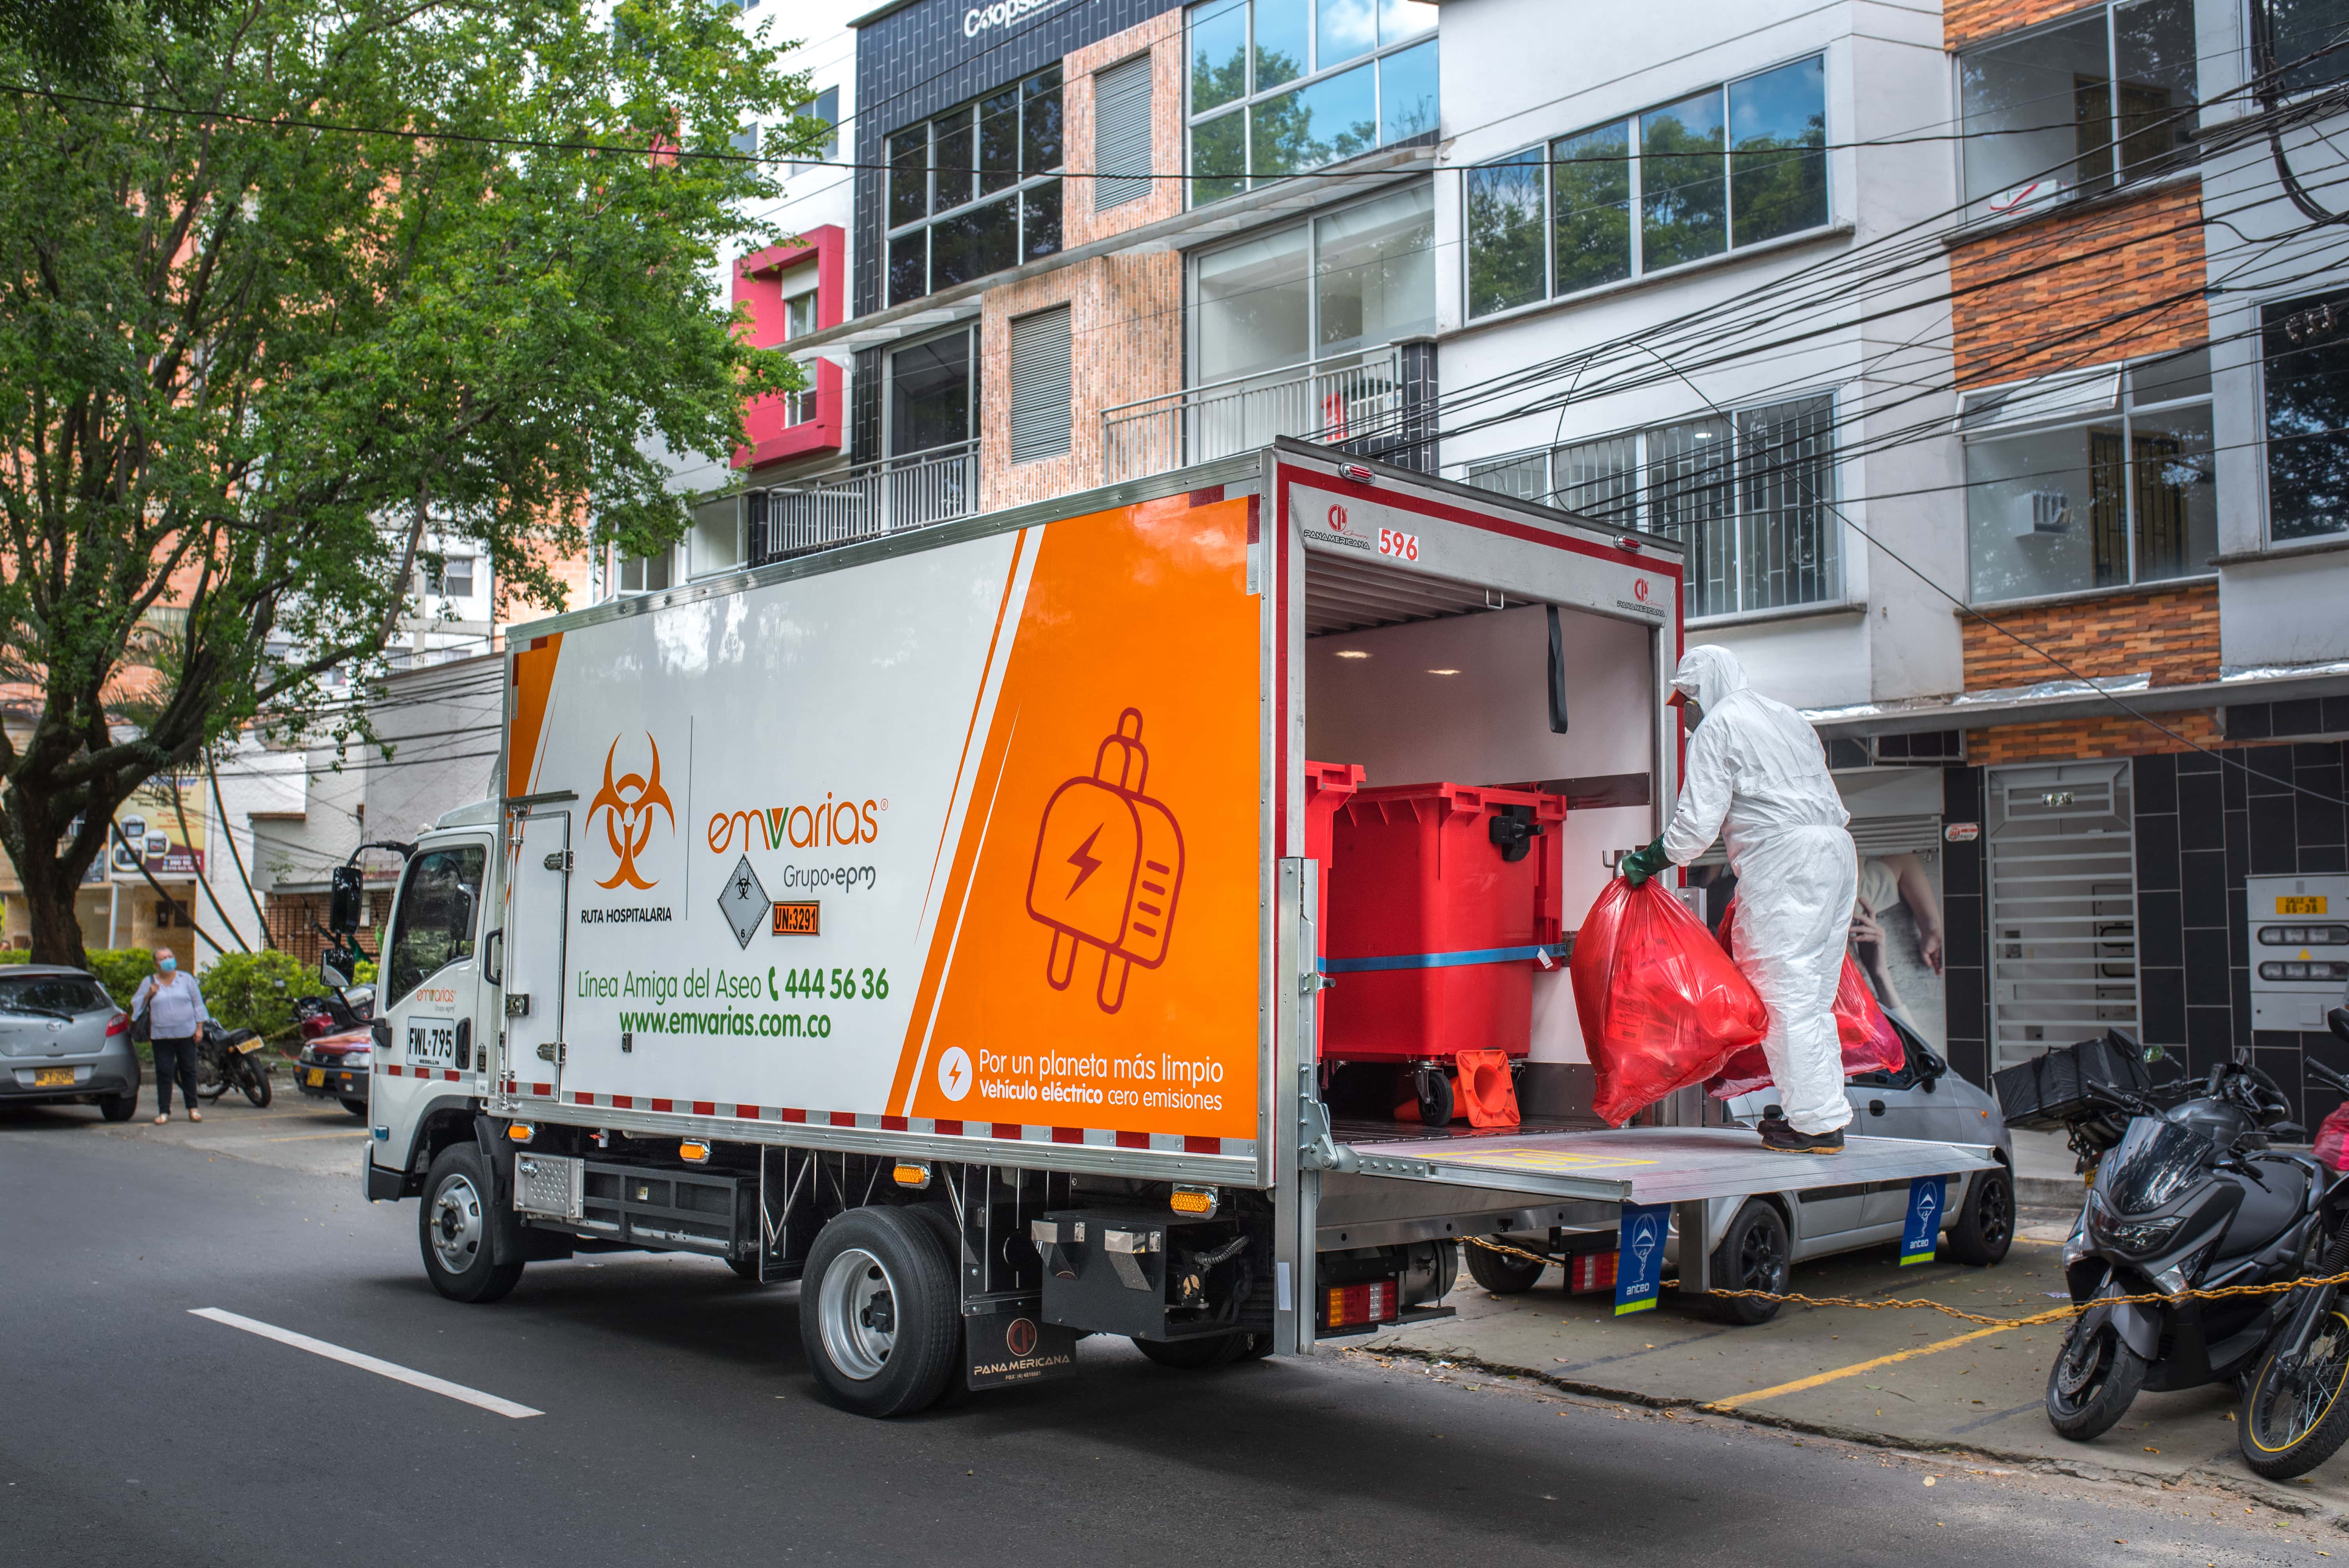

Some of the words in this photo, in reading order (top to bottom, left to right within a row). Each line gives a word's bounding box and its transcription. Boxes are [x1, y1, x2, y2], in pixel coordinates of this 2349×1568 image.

[1304, 529, 1370, 550] PANAMERICANA
[1380, 529, 1417, 561] 596
[1617, 600, 1665, 617] PANAMERICANA
[581, 909, 604, 923] RUTA
[606, 907, 672, 923] HOSPITALARIA
[775, 908, 815, 930] UN:3291
[2286, 904, 2318, 913] 66-38
[741, 929, 745, 938] 6
[578, 971, 618, 998] Línea
[624, 970, 677, 1005] Amiga
[684, 968, 709, 998] del
[715, 969, 761, 998] Aseo
[784, 968, 825, 999] 444
[830, 968, 856, 999] 56
[861, 968, 889, 1000] 36
[620, 1005, 831, 1038] www.emvarias.com.co
[980, 1049, 1007, 1073] Por
[1012, 1055, 1033, 1074] un
[1040, 1049, 1107, 1081] planeta
[1114, 1053, 1156, 1080] más
[1162, 1053, 1223, 1089] limpio
[980, 1079, 1037, 1100] Vehículo
[1041, 1081, 1103, 1104] eléctrico
[1108, 1090, 1139, 1106] cero
[1143, 1088, 1222, 1111] emisiones
[1909, 1239, 1928, 1249] anteo
[1626, 1283, 1649, 1295] anteo
[974, 1354, 1070, 1376] PANAMERICANA
